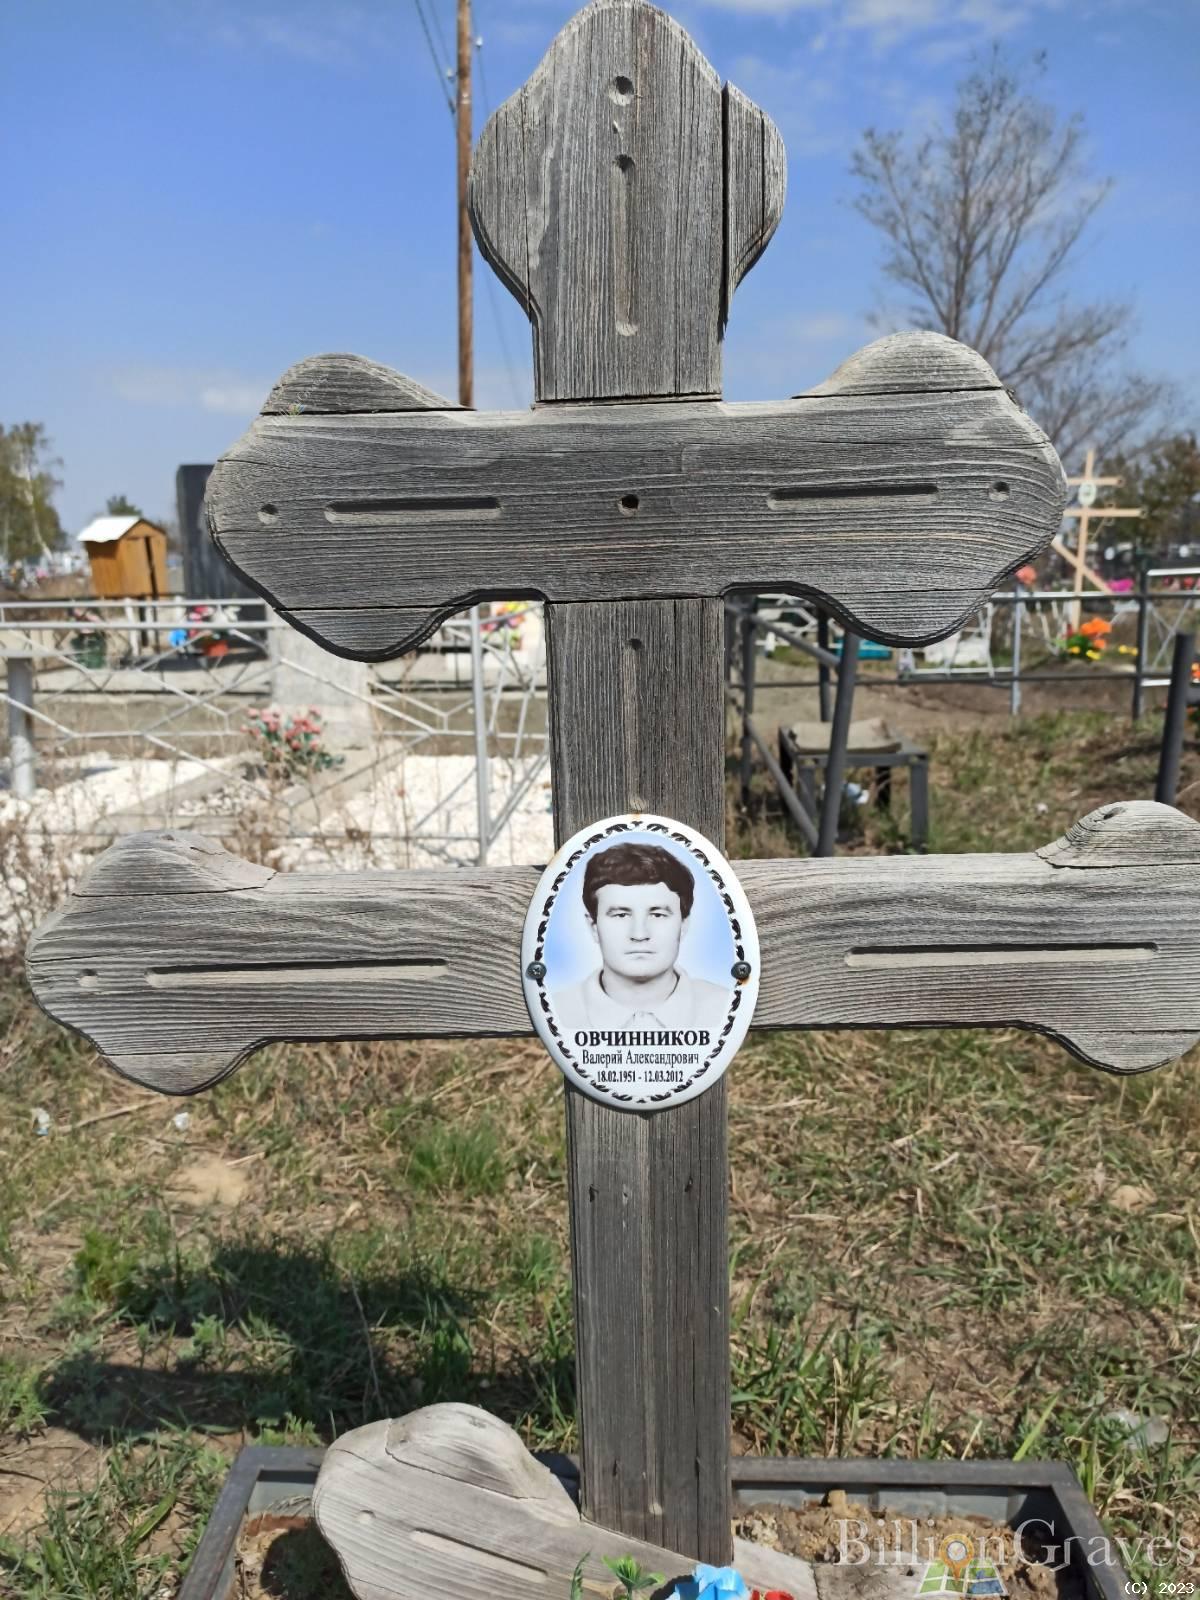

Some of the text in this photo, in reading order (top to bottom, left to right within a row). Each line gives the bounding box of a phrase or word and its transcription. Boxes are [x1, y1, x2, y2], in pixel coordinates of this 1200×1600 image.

[574, 1030, 711, 1046] ОВЧИННИКОВ
[582, 1049, 699, 1068] Валерий Александрович
[597, 1070, 636, 1082] 18.02.1951
[644, 1070, 684, 1082] 12.03.2012
